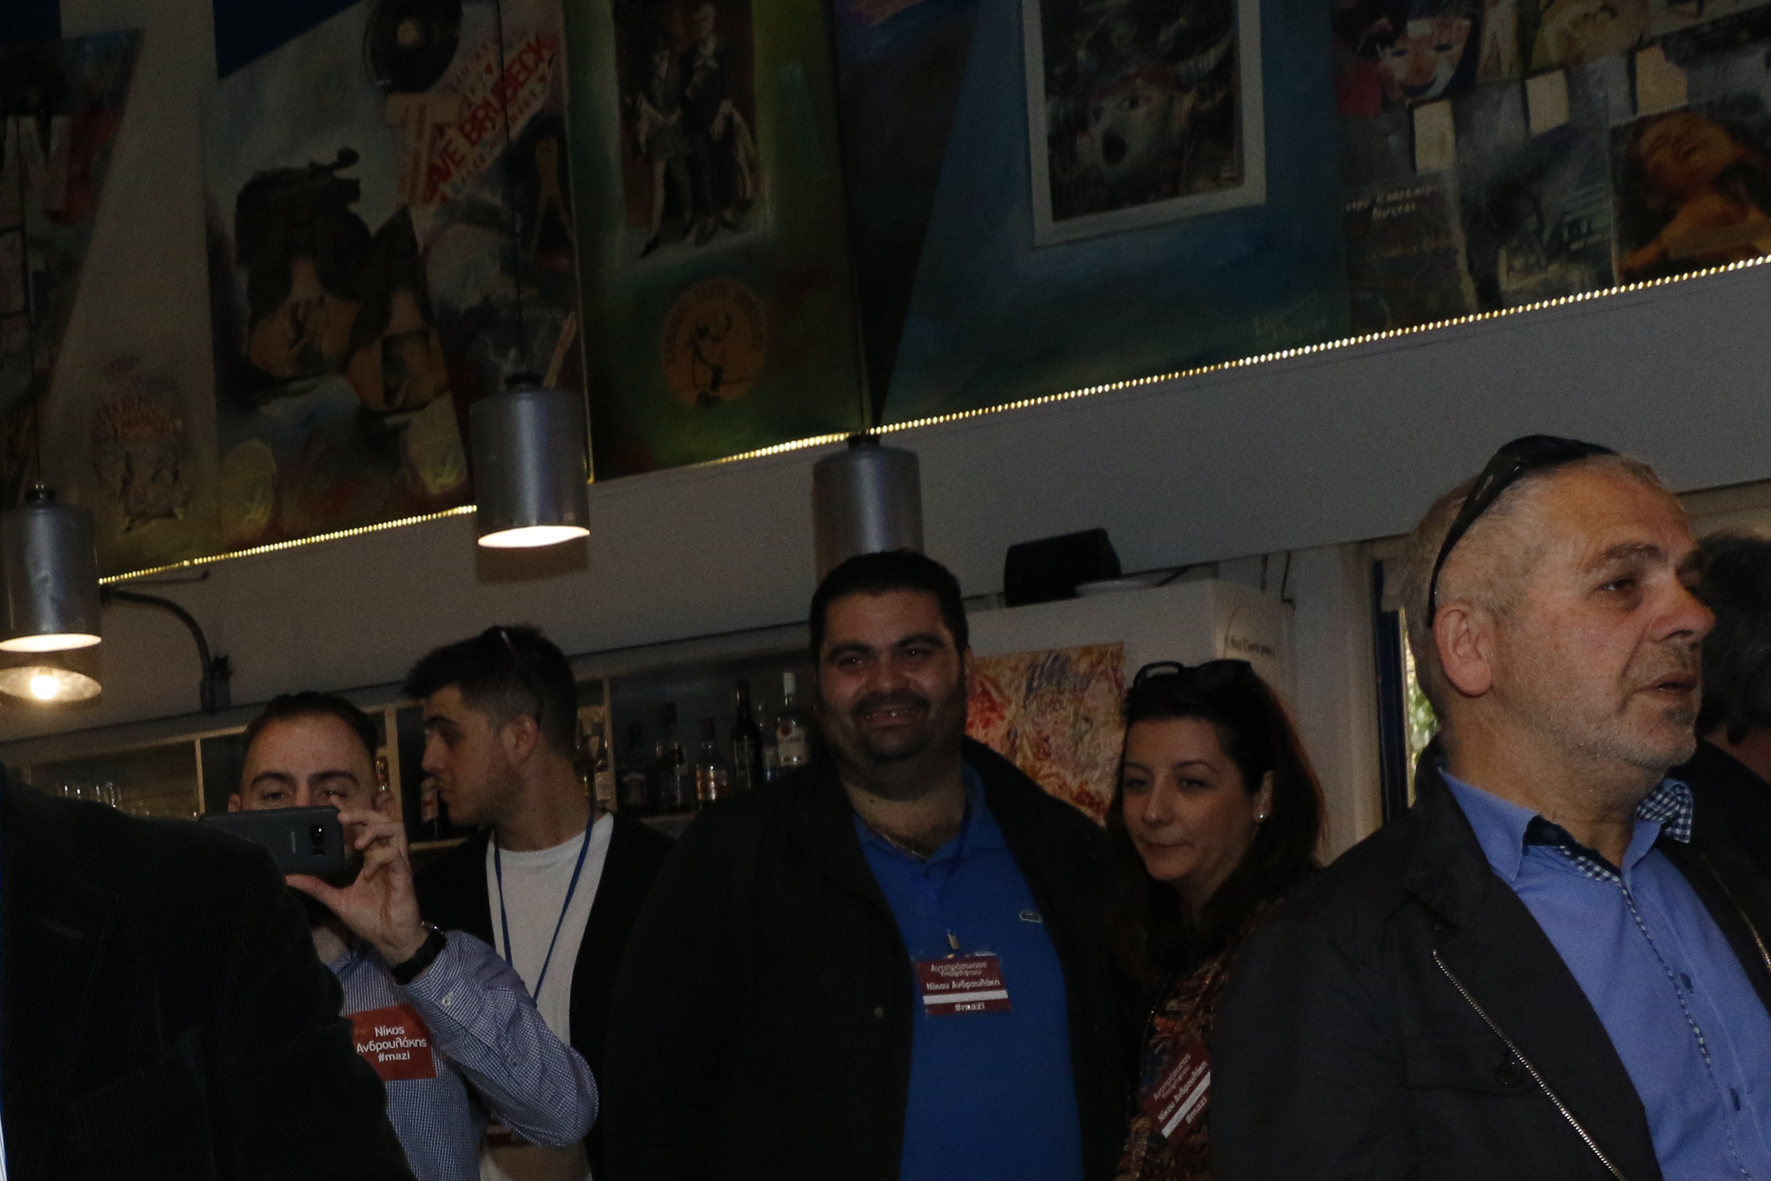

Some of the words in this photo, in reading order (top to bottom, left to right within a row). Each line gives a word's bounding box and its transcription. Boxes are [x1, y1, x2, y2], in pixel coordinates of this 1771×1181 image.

[459, 38, 548, 146] BRUBECK
[926, 981, 950, 991] Νίκου
[951, 978, 1001, 990] Ανδρουλάκη
[954, 1001, 986, 1012] #mazi
[374, 1025, 405, 1038] Νίκος
[356, 1036, 427, 1054] Ανδρουλάκης
[377, 1050, 411, 1063] #mazi
[1157, 1102, 1176, 1123] Νίκου
[1173, 1060, 1208, 1104] Ανδρουλάκη
[1185, 1095, 1208, 1125] #mazi
